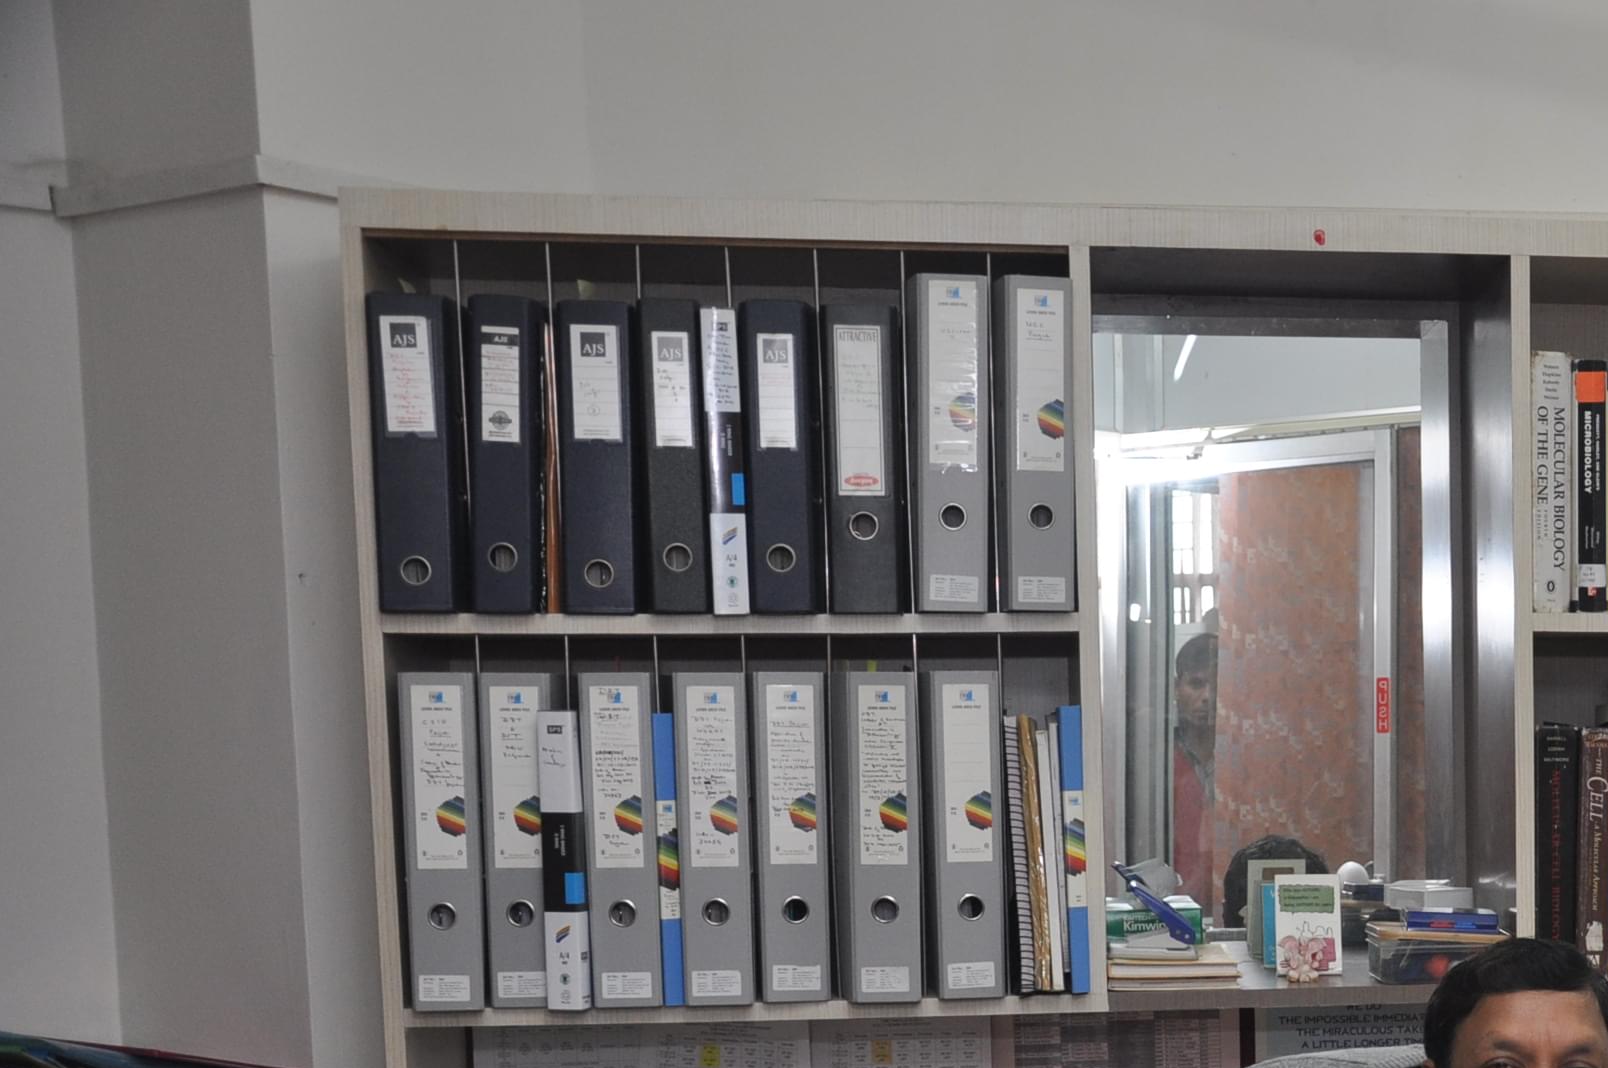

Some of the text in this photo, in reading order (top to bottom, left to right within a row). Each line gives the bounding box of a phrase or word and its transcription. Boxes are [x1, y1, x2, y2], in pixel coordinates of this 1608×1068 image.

[1536, 405, 1549, 505] OF THE GENE
[1584, 410, 1593, 495] MICROBIOLOGY
[1551, 407, 1566, 572] MOLECULAR BIOLOGY
[1586, 775, 1608, 823] CELL
[1278, 1013, 1371, 1025] THE IMPOSSIBLE
[1295, 1025, 1393, 1037] THE MIRACULOUS
[1301, 1038, 1401, 1049] A LITTLE LONGER
